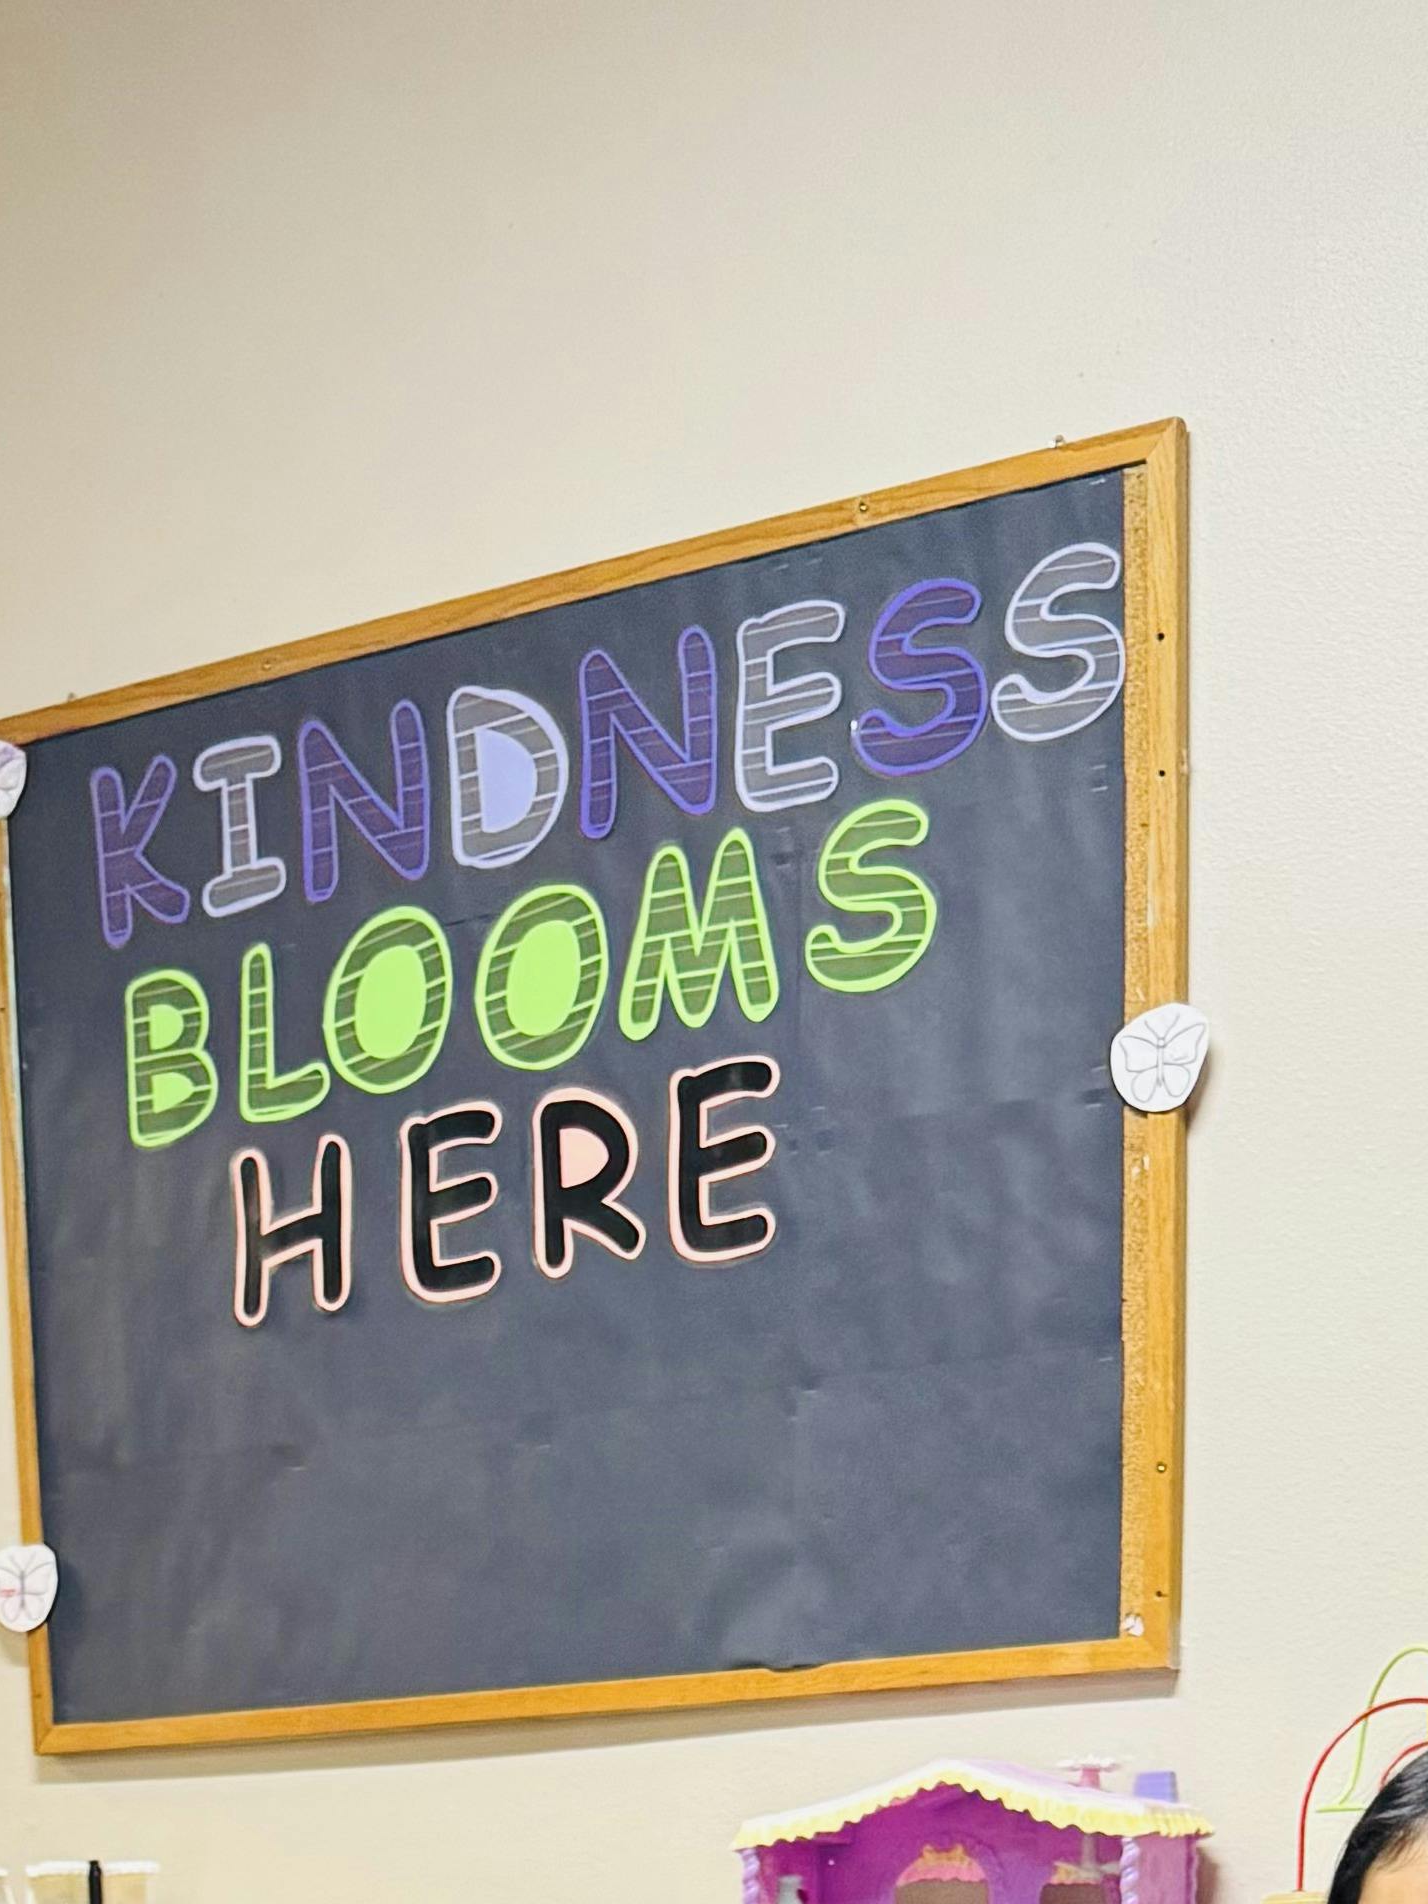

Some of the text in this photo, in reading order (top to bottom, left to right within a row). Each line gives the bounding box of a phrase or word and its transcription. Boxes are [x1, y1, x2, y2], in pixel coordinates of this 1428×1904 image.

[91, 540, 1125, 950] KINDNESS
[125, 799, 938, 1150] BLOOMS
[232, 1055, 780, 1328] HERE
